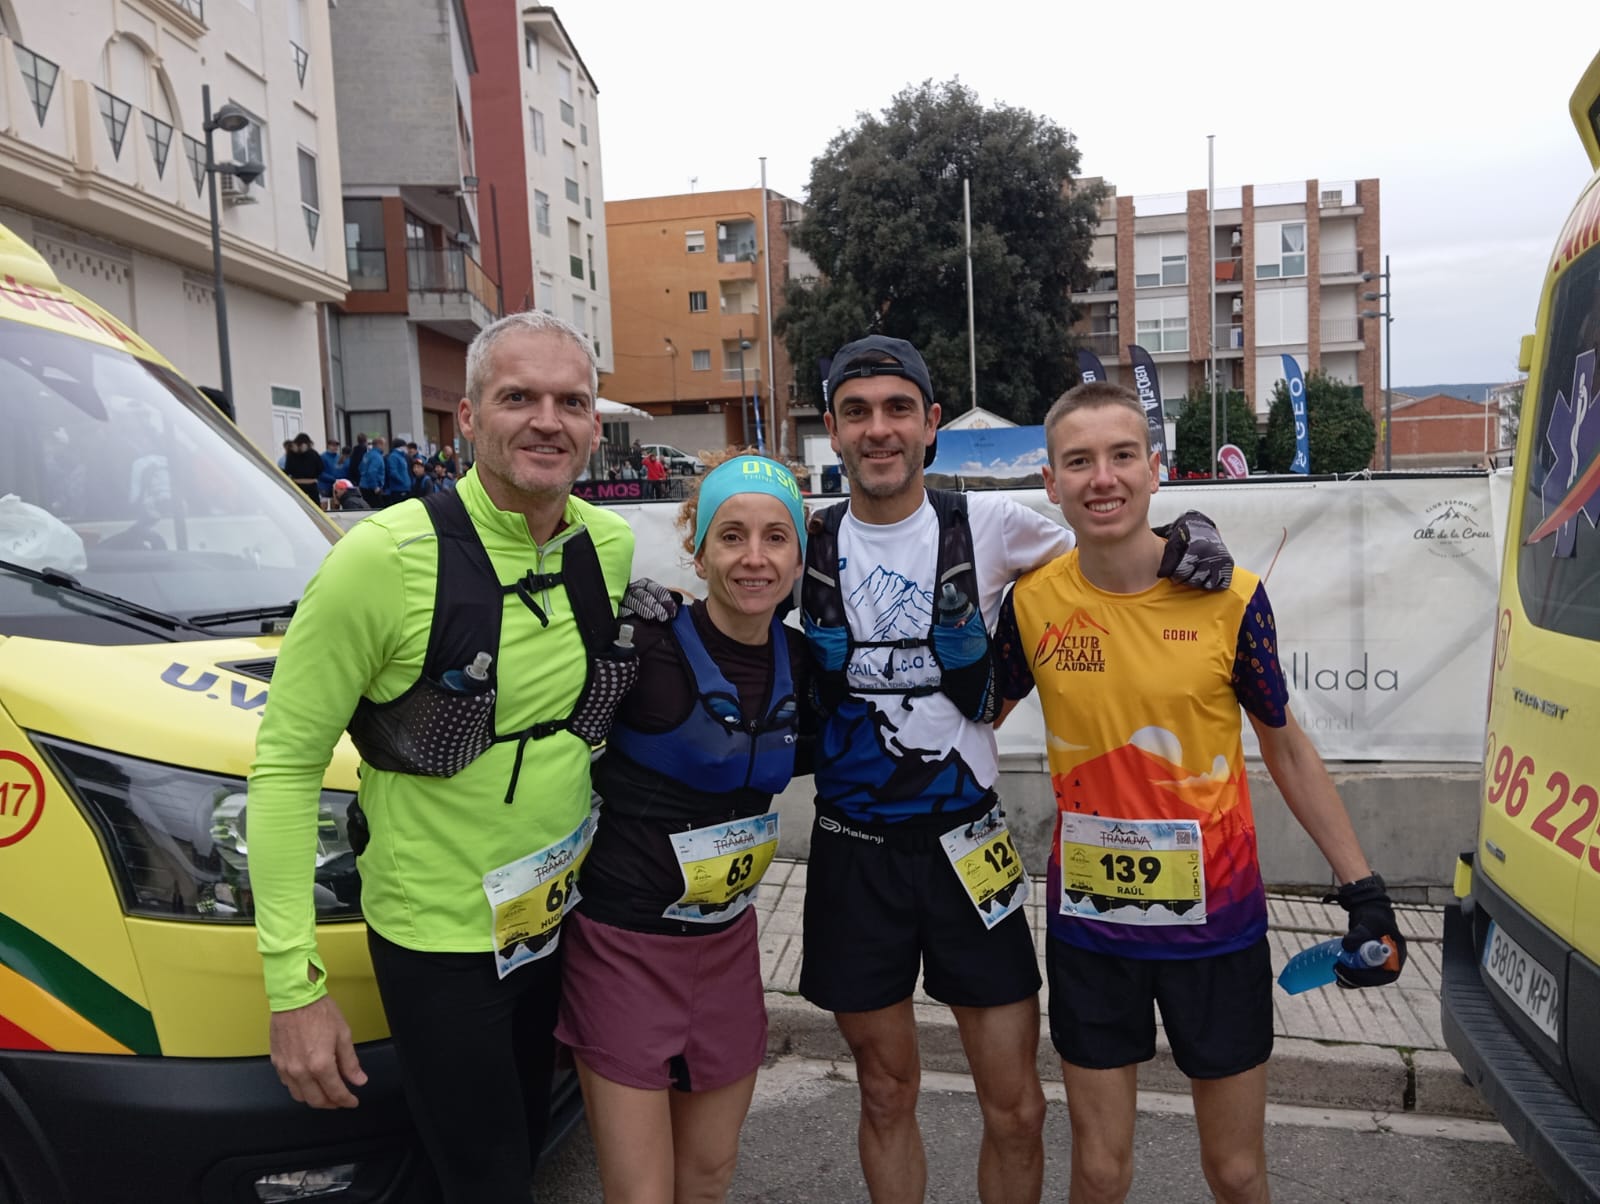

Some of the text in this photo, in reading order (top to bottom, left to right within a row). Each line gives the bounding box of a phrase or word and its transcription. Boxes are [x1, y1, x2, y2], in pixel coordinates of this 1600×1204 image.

[1290, 377, 1305, 440] GEO
[742, 460, 799, 500] OTSO
[1061, 635, 1100, 649] CLUB
[1163, 629, 1198, 641] GOBIK
[1055, 661, 1105, 672] CAUDETE
[1056, 649, 1106, 662] TRAIL
[1283, 651, 1398, 691] llada
[1512, 687, 1569, 720] TRANSIT
[1488, 745, 1535, 817] 96
[842, 825, 884, 845] Kalenji
[984, 834, 1015, 873] 12
[1100, 853, 1162, 884] 139
[726, 853, 753, 887] 63
[1117, 886, 1145, 896] RAÚL
[541, 911, 562, 929] HUG
[1490, 935, 1527, 995] 3806
